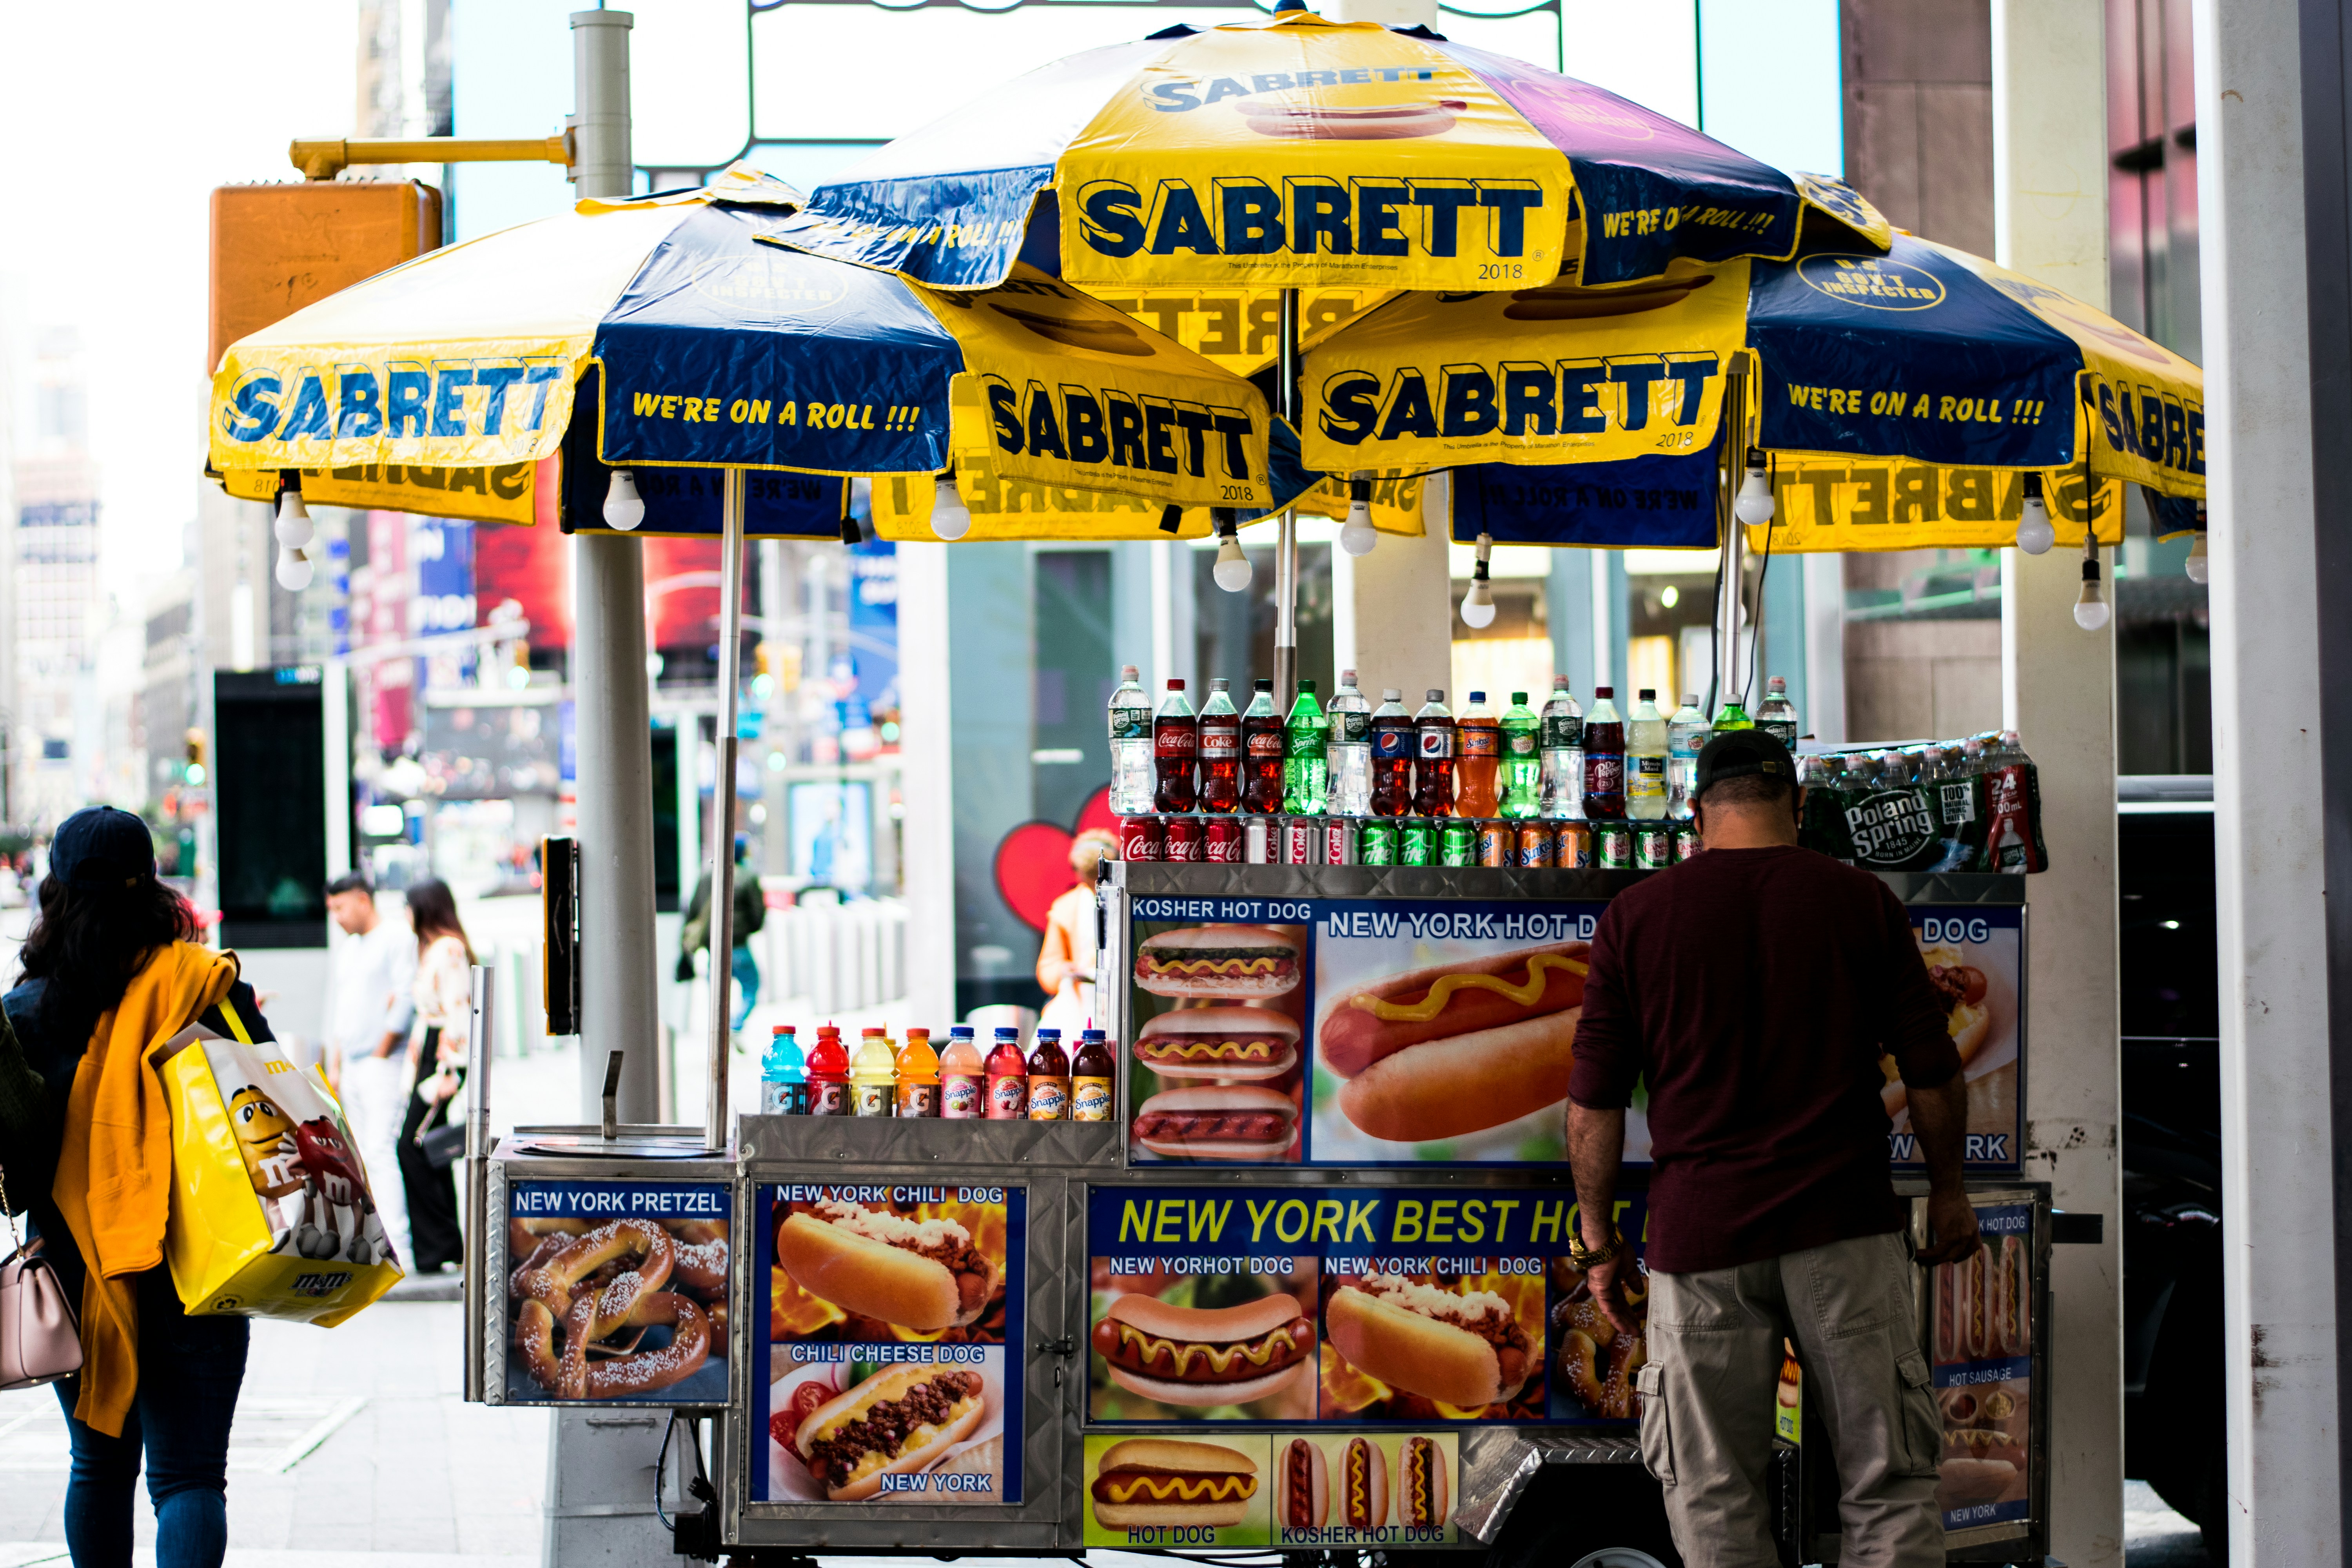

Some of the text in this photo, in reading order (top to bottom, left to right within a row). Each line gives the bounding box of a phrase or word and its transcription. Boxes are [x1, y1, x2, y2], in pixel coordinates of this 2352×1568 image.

[1142, 65, 1438, 113] SABRETT
[1076, 176, 1543, 259] SABRETT
[1602, 207, 1775, 238] WE'RE ROLL !!!
[943, 222, 991, 249] ROLL
[995, 220, 1020, 245] !!!
[1477, 265, 1523, 281] 2018
[1833, 259, 1883, 271] U.S.
[1834, 271, 1905, 288] GOV'T
[711, 284, 833, 301] INSPECTED
[1821, 281, 1937, 299] INSPECTED
[221, 356, 570, 442] SABRETT
[1318, 350, 1719, 445] SABRETT
[1787, 383, 2045, 425] WE'RE ON A ROLL !!!
[632, 392, 920, 432] WE'RE ON A ROLL !!!
[982, 372, 1254, 481] SABRETT
[2095, 371, 2207, 477] SABRE
[1500, 441, 1526, 450] Property
[1655, 431, 1694, 448] 2018
[1221, 485, 1254, 502] 2018
[1113, 711, 1129, 719] Poland
[1114, 716, 1130, 726] Spring
[1345, 715, 1363, 724] Poland
[1558, 719, 1576, 728] Poland
[1346, 721, 1364, 730] Spring
[1559, 725, 1577, 733] Spring
[1158, 732, 1196, 748] Coca-Cola
[1203, 736, 1232, 748] Coke
[1247, 733, 1284, 748] Coca-Cola
[1292, 737, 1318, 749] Sprite
[1466, 736, 1491, 749] Sunkist
[1597, 763, 1621, 778] Pepper
[1605, 761, 1615, 769] Dr
[1942, 784, 1970, 801] 100%
[1991, 772, 2017, 796] 24
[1844, 787, 1927, 836] Poland
[1944, 799, 1970, 808] NATURAL
[1945, 806, 1967, 815] SPRING
[1945, 813, 1966, 822] WATER
[1851, 808, 1935, 858] Spring
[1267, 827, 1278, 859] Coke
[1294, 827, 1306, 860] Coke
[1329, 828, 1343, 861] Coke
[1520, 835, 1553, 866] Sunkist
[1885, 837, 1908, 850] 1845
[1903, 836, 1921, 853] MAINE
[1132, 899, 1312, 920] KOSHER HOT DOG
[1330, 912, 1399, 936] NEW
[1409, 913, 1495, 938] YORK
[1504, 914, 1568, 939] HOT
[1924, 917, 1988, 942] DOG
[772, 1085, 793, 1109] G
[821, 1086, 840, 1110] G
[860, 1088, 881, 1112] G
[909, 1087, 929, 1112] G
[945, 1085, 976, 1100] Snapple
[995, 1085, 1024, 1099] Snapple
[1031, 1091, 1066, 1109] Snapple
[1075, 1093, 1111, 1110] Snapple
[323, 1170, 352, 1204] m
[776, 1185, 1004, 1204] NEW YORK CHILI DOG
[515, 1191, 723, 1212] NEW YORK PRETZEL
[1118, 1199, 1522, 1243] NEW YORK BEST
[1986, 1217, 2004, 1231] HOT
[2006, 1216, 2026, 1229] DOG
[1109, 1257, 1294, 1275] NEW YORHOT DOG
[1325, 1257, 1542, 1276] NEW YORK CHILI DOG
[791, 1345, 984, 1363] CHILI CHEESE DOG
[1949, 1367, 2012, 1387] HOT SAUSAGE
[881, 1473, 992, 1492] NEW YORK
[1950, 1503, 1996, 1523] NEW YORK
[1127, 1524, 1216, 1544] HOT DOG
[1281, 1525, 1445, 1543] KOSHER HOT DOG
